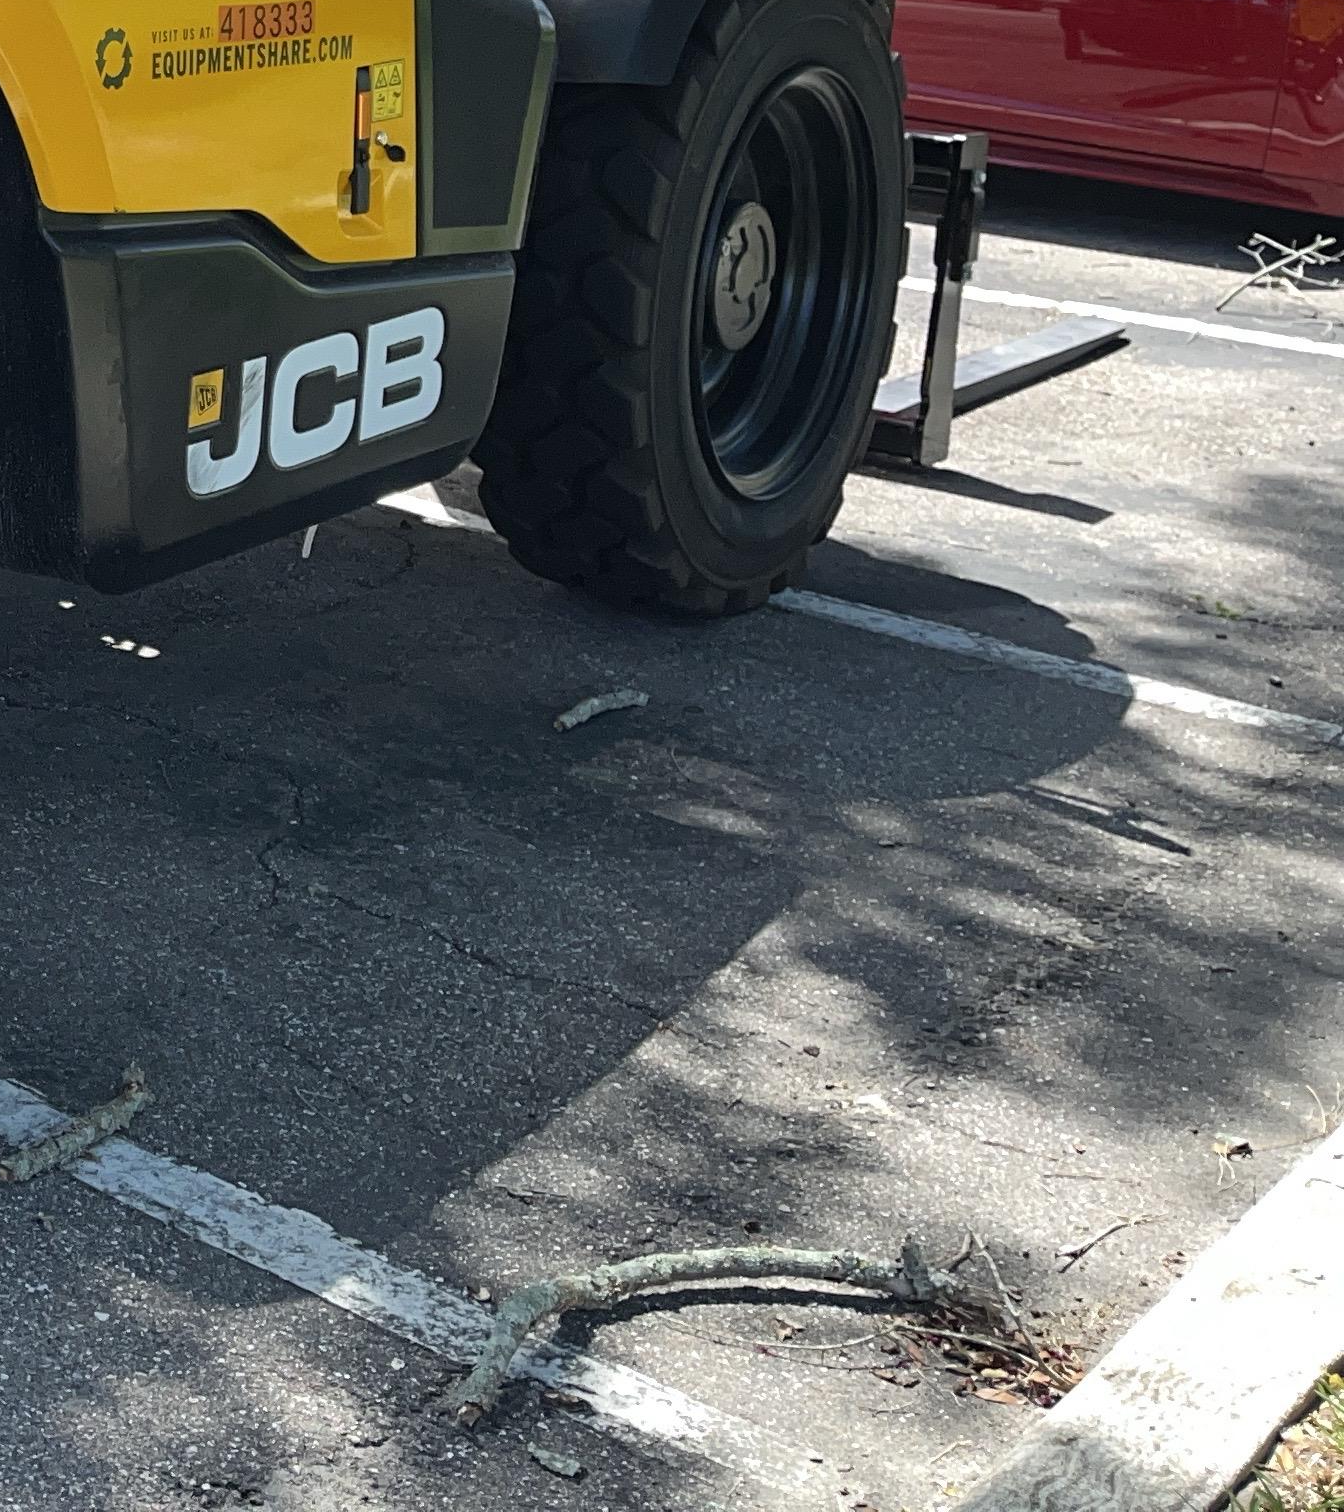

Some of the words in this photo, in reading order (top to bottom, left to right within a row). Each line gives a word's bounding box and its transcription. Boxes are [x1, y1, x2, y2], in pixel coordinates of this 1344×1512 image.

[152, 29, 178, 44] VISIT
[183, 27, 195, 41] US
[220, 0, 313, 41] 418333
[152, 35, 353, 80] EQUIPMENTSHARE.COM
[187, 306, 445, 495] JCB
